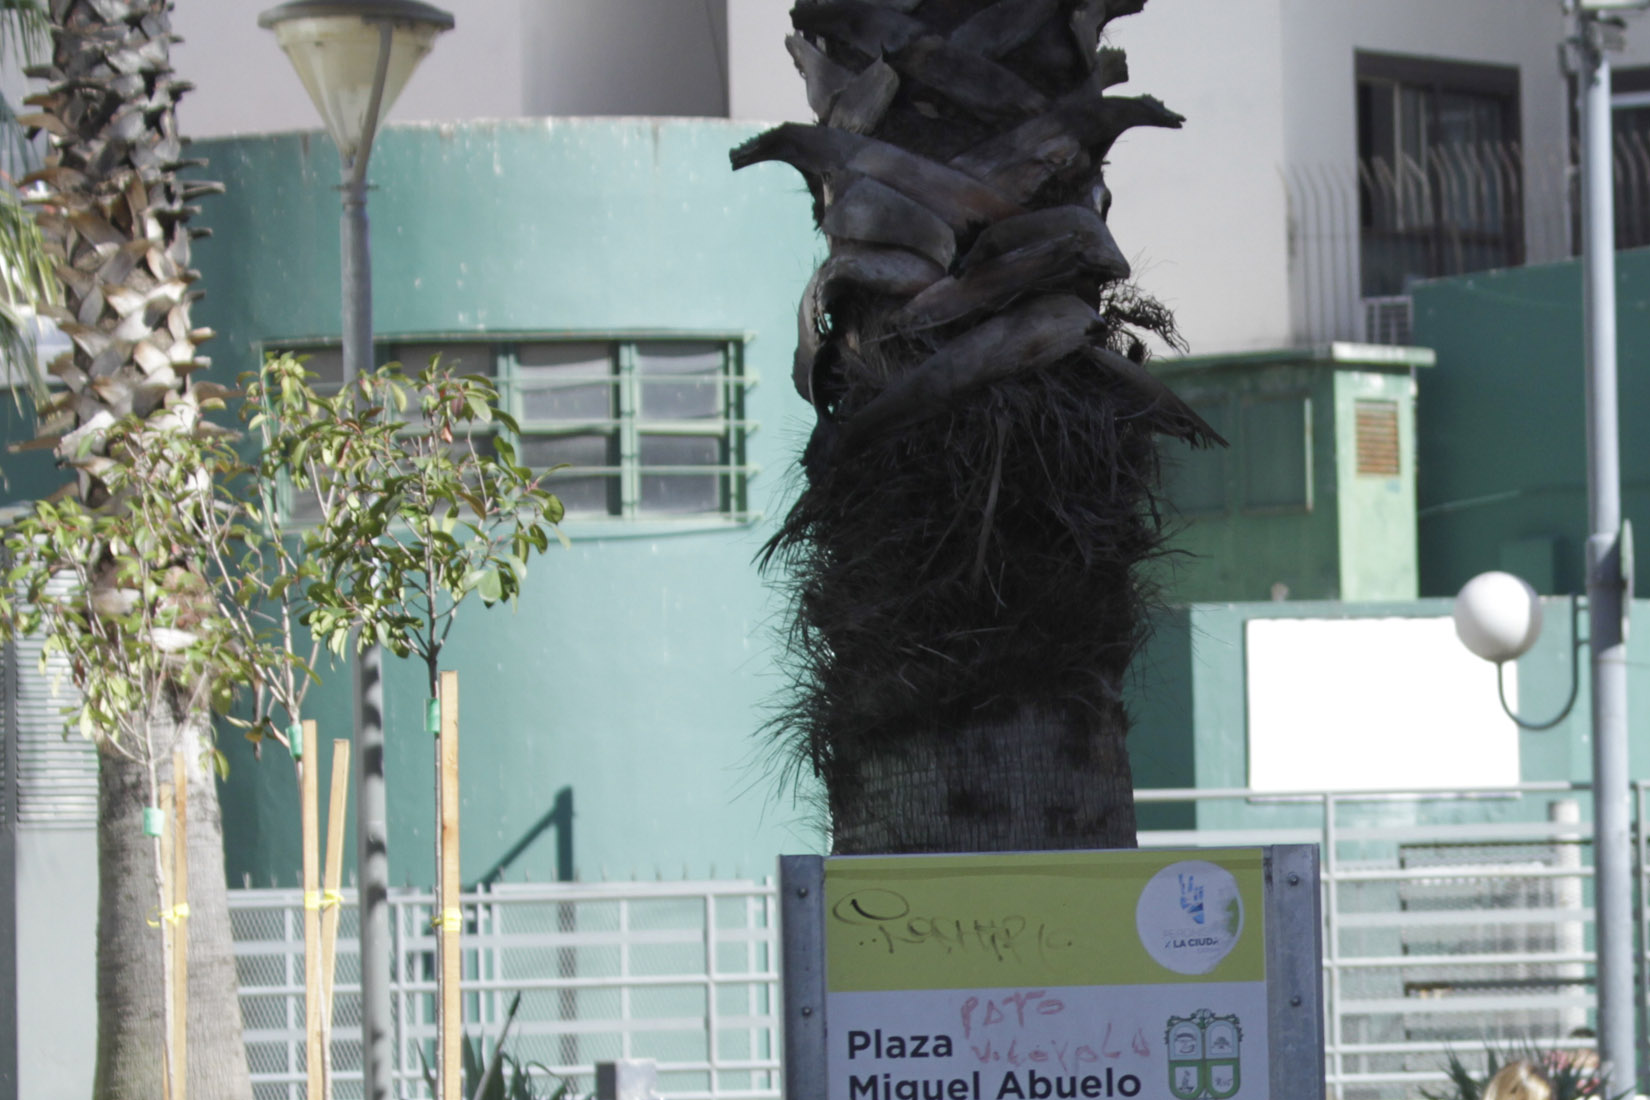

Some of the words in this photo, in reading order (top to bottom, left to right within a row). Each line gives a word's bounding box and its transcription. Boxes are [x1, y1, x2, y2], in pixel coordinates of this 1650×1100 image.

[1173, 939, 1186, 948] LA
[848, 1029, 953, 1060] Plaza
[996, 1067, 1142, 1100] Abuelo
